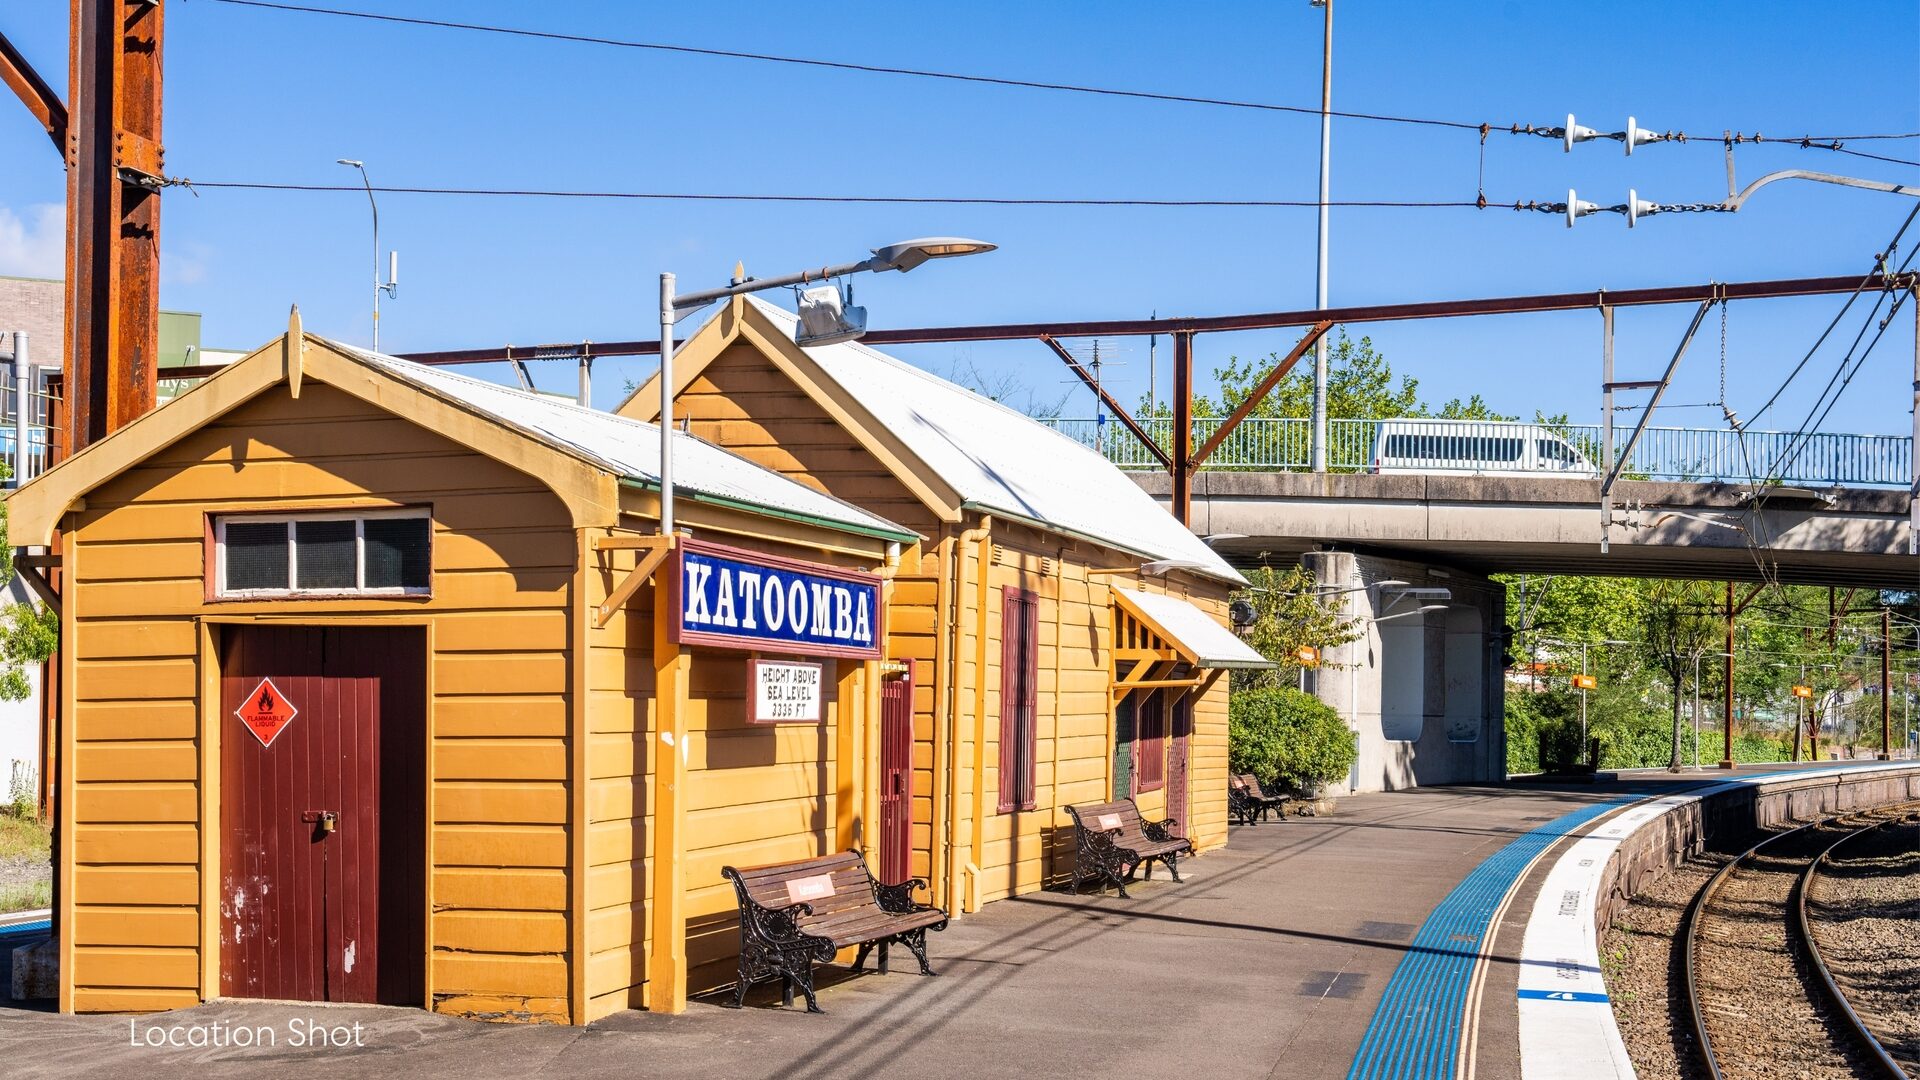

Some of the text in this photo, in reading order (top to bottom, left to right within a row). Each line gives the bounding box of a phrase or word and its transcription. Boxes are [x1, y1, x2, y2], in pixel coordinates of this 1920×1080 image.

[685, 562, 871, 641] KATOOMBA
[762, 668, 817, 685] HEIGHT ABOVE
[768, 686, 812, 701] SEA LEVEL
[772, 703, 806, 717] 3336 FT
